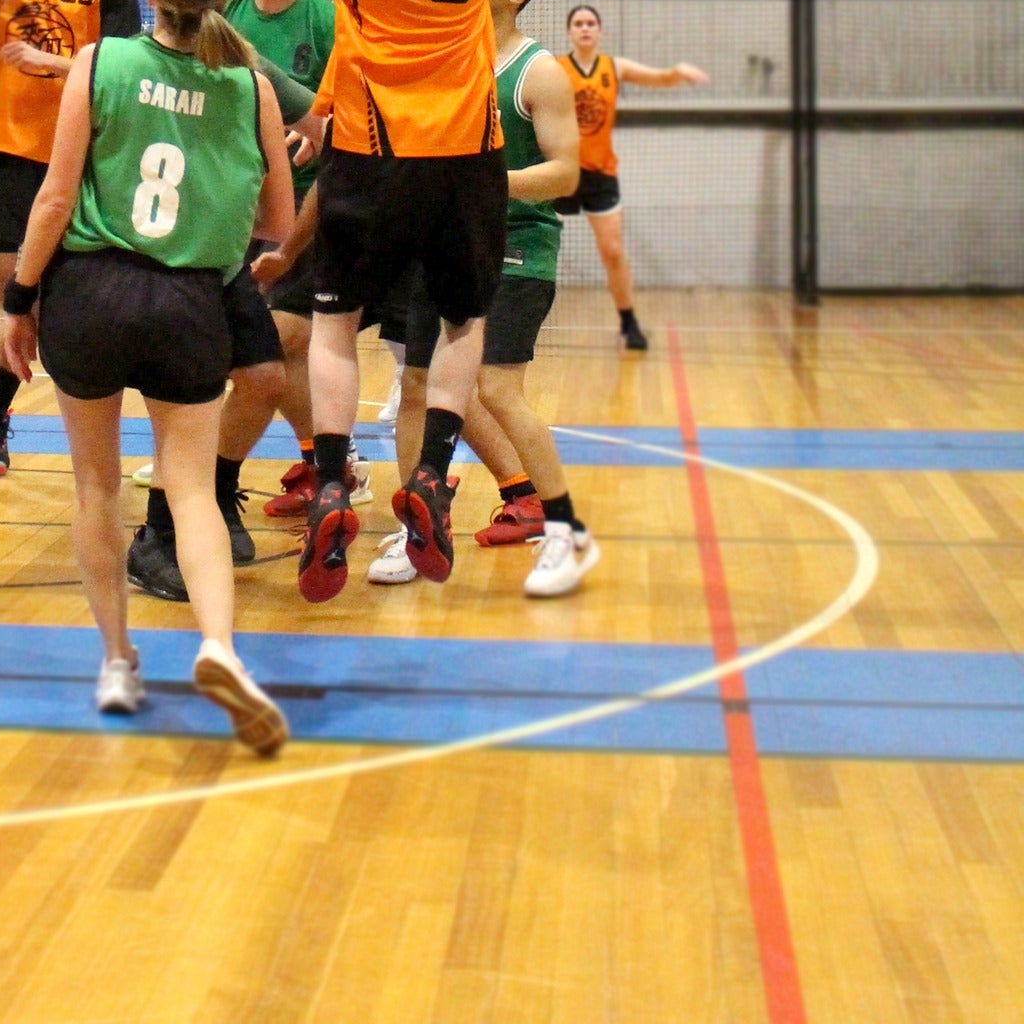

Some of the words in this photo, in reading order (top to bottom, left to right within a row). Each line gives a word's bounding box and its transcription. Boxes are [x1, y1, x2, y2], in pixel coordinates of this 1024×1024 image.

[292, 43, 312, 75] 6
[138, 78, 206, 117] SARAH
[131, 142, 186, 239] 8
